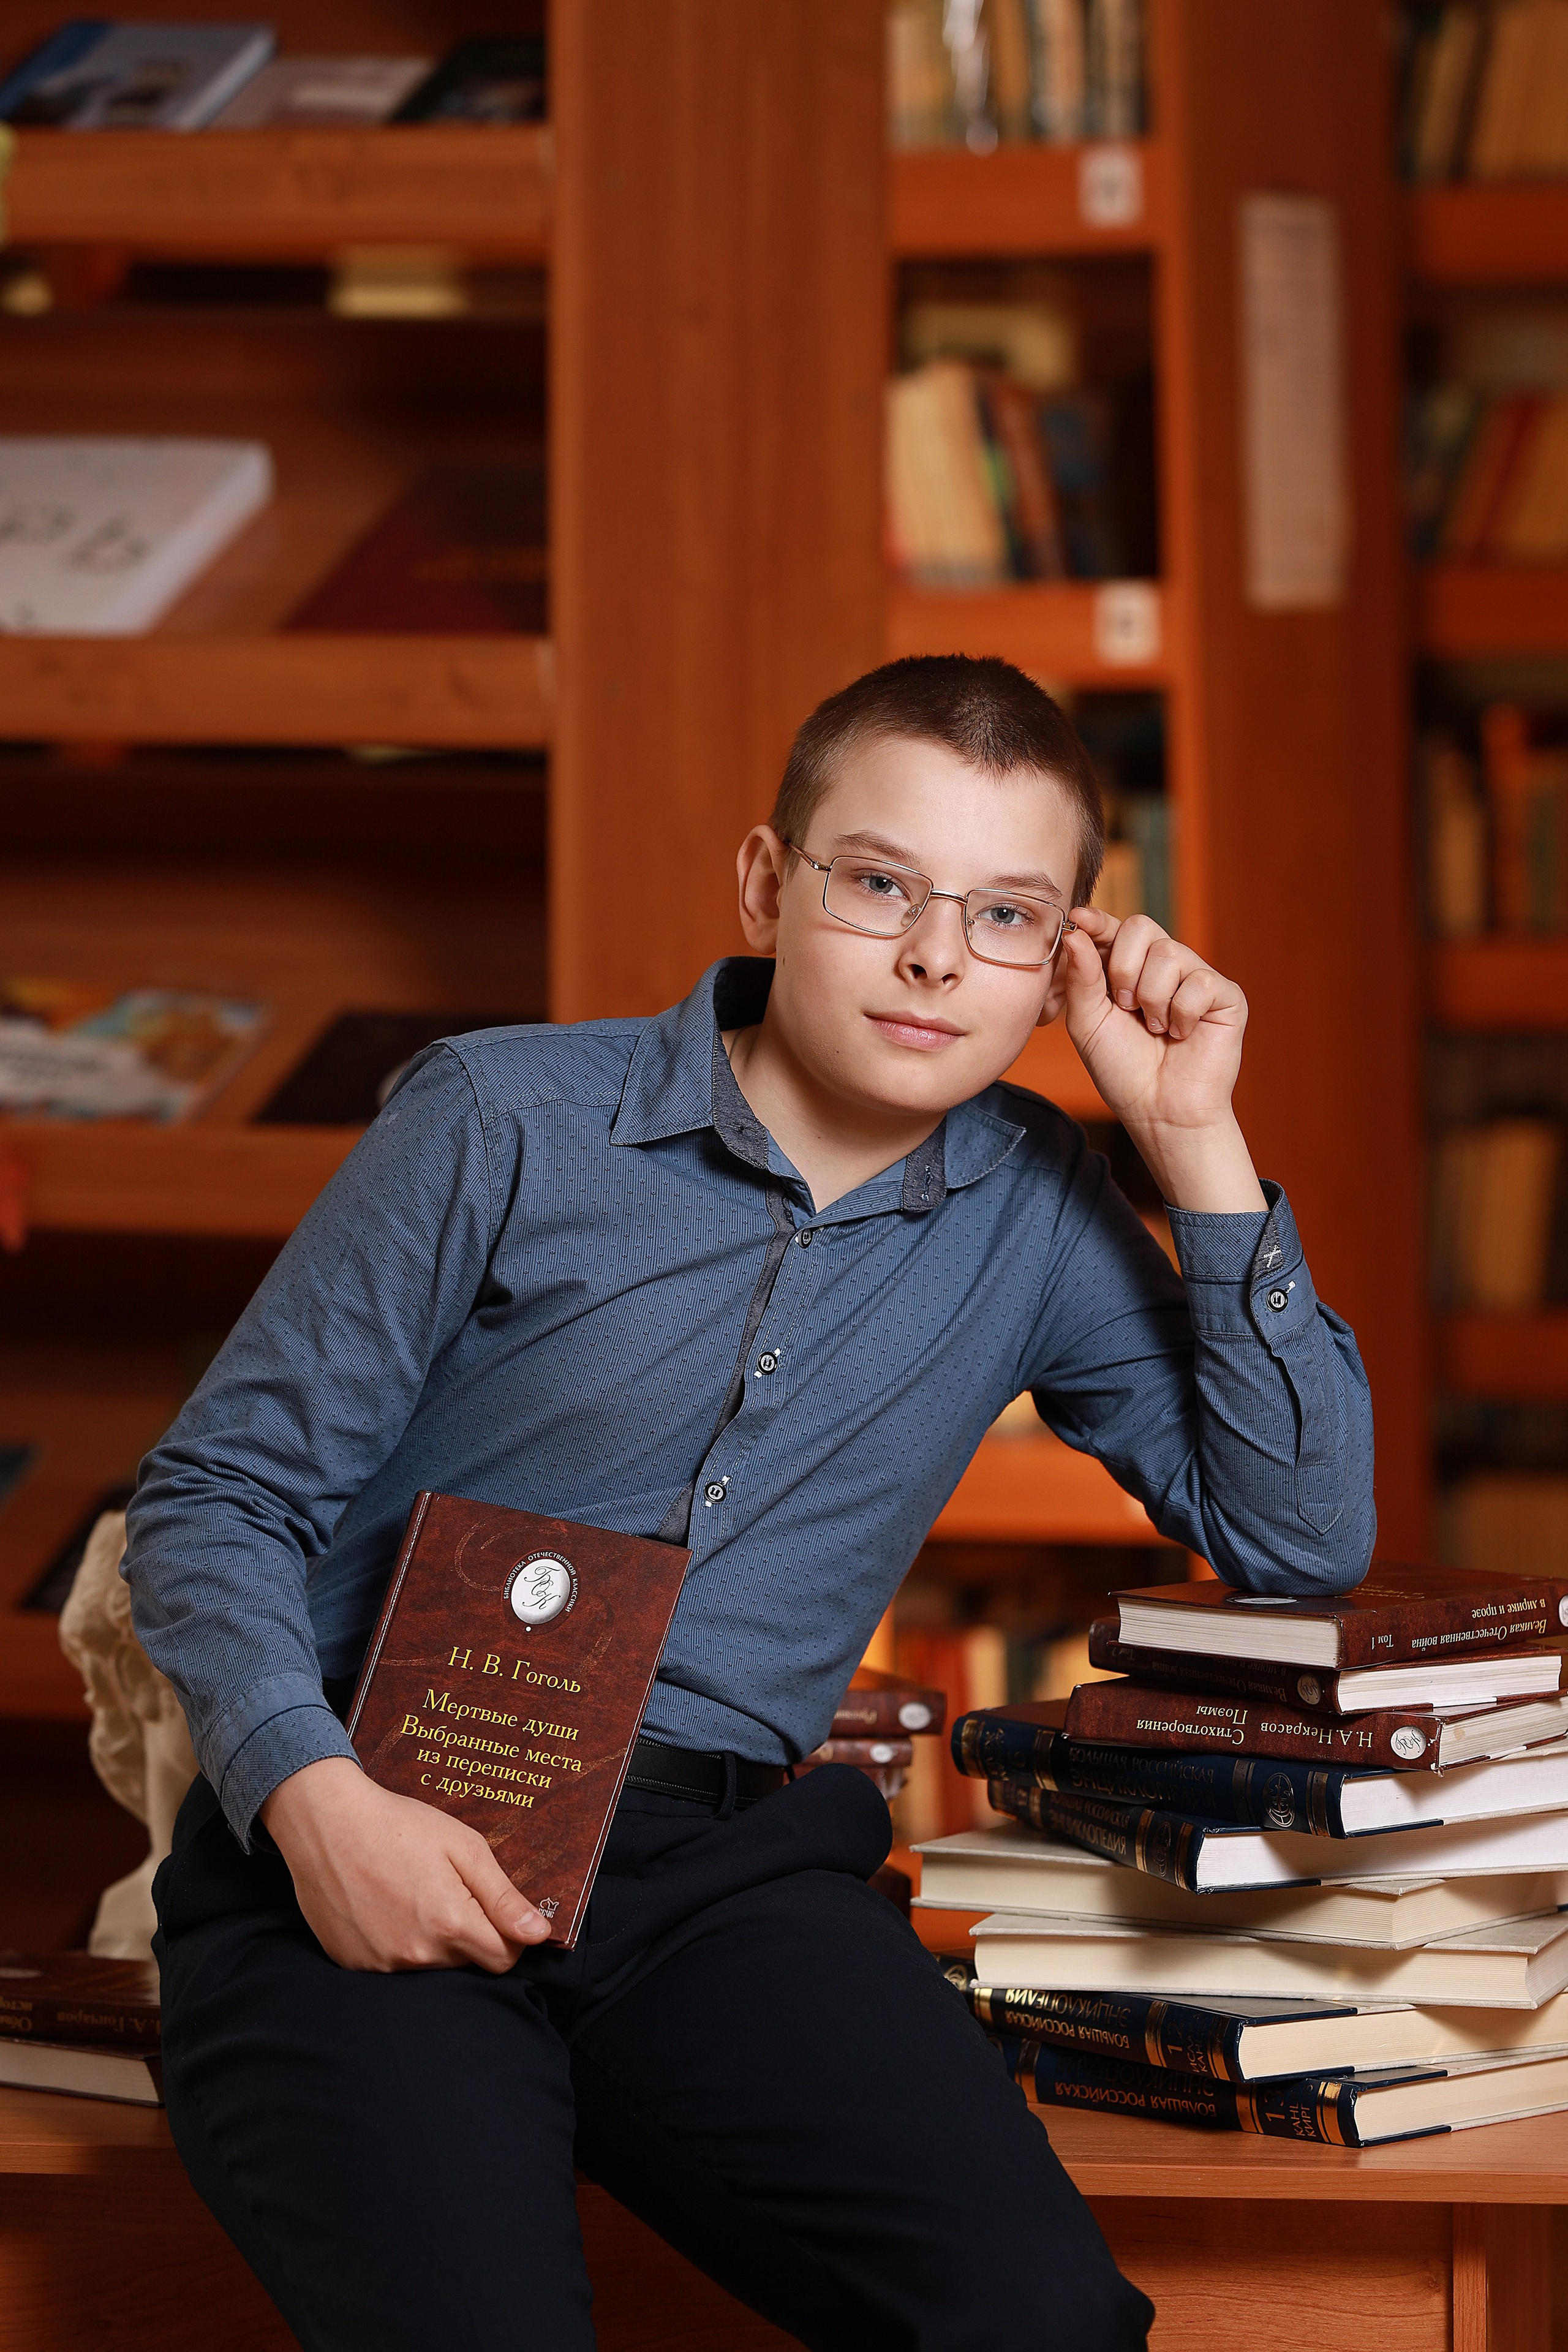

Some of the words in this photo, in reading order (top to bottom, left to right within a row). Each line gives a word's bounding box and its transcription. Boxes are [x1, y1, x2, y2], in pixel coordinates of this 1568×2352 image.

[503, 1561, 527, 1599] БИБЛИОТЕКА
[527, 1551, 577, 1576] ОТЕЧЕСТВЕННОЙ
[565, 1578, 578, 1612] КЛАССИКИ
[1471, 1604, 1498, 1618] прозе
[1499, 1605, 1505, 1614] и
[1506, 1597, 1537, 1614] лирике
[1540, 1599, 1546, 1608] в
[1440, 1626, 1507, 1644] Отечественная
[1509, 1619, 1547, 1634] Великая
[1371, 1637, 1376, 1650] 1
[1378, 1634, 1394, 1648] Том
[1411, 1635, 1438, 1651] война
[447, 1646, 474, 1671] Н.
[481, 1653, 503, 1677] В.
[511, 1659, 582, 1693] Гоголь
[1180, 1668, 1246, 1694] Отечественная
[1248, 1682, 1287, 1703] Великая
[422, 1689, 518, 1727] Мертвые
[522, 1719, 579, 1741] души
[1196, 1705, 1248, 1725] Поэмы
[400, 1714, 520, 1758] Выбранные
[524, 1749, 582, 1773] места
[1136, 1719, 1245, 1745] Стихотворения
[1260, 1722, 1333, 1745] Некрасов
[416, 1749, 441, 1764] из
[445, 1755, 552, 1789] переписки
[1069, 1746, 1128, 1770] БОЛЬШАЯ
[1133, 1756, 1214, 1784] РОССИЙСКАЯ
[420, 1773, 432, 1785] с
[435, 1776, 535, 1808] друзьями
[1005, 1989, 1131, 2029] ЭНЦИКЛОПЕДИЯ
[1004, 2010, 1076, 2038] РОССИЙСКАЯ
[1077, 2024, 1130, 2049] БОЛЬШАЯ
[1166, 2021, 1185, 2055] 12
[1054, 2081, 1147, 2107] РОССИЙСКАЯ
[1150, 2095, 1218, 2117] БОЛЬШАЯ
[1264, 2089, 1286, 2122] 13
